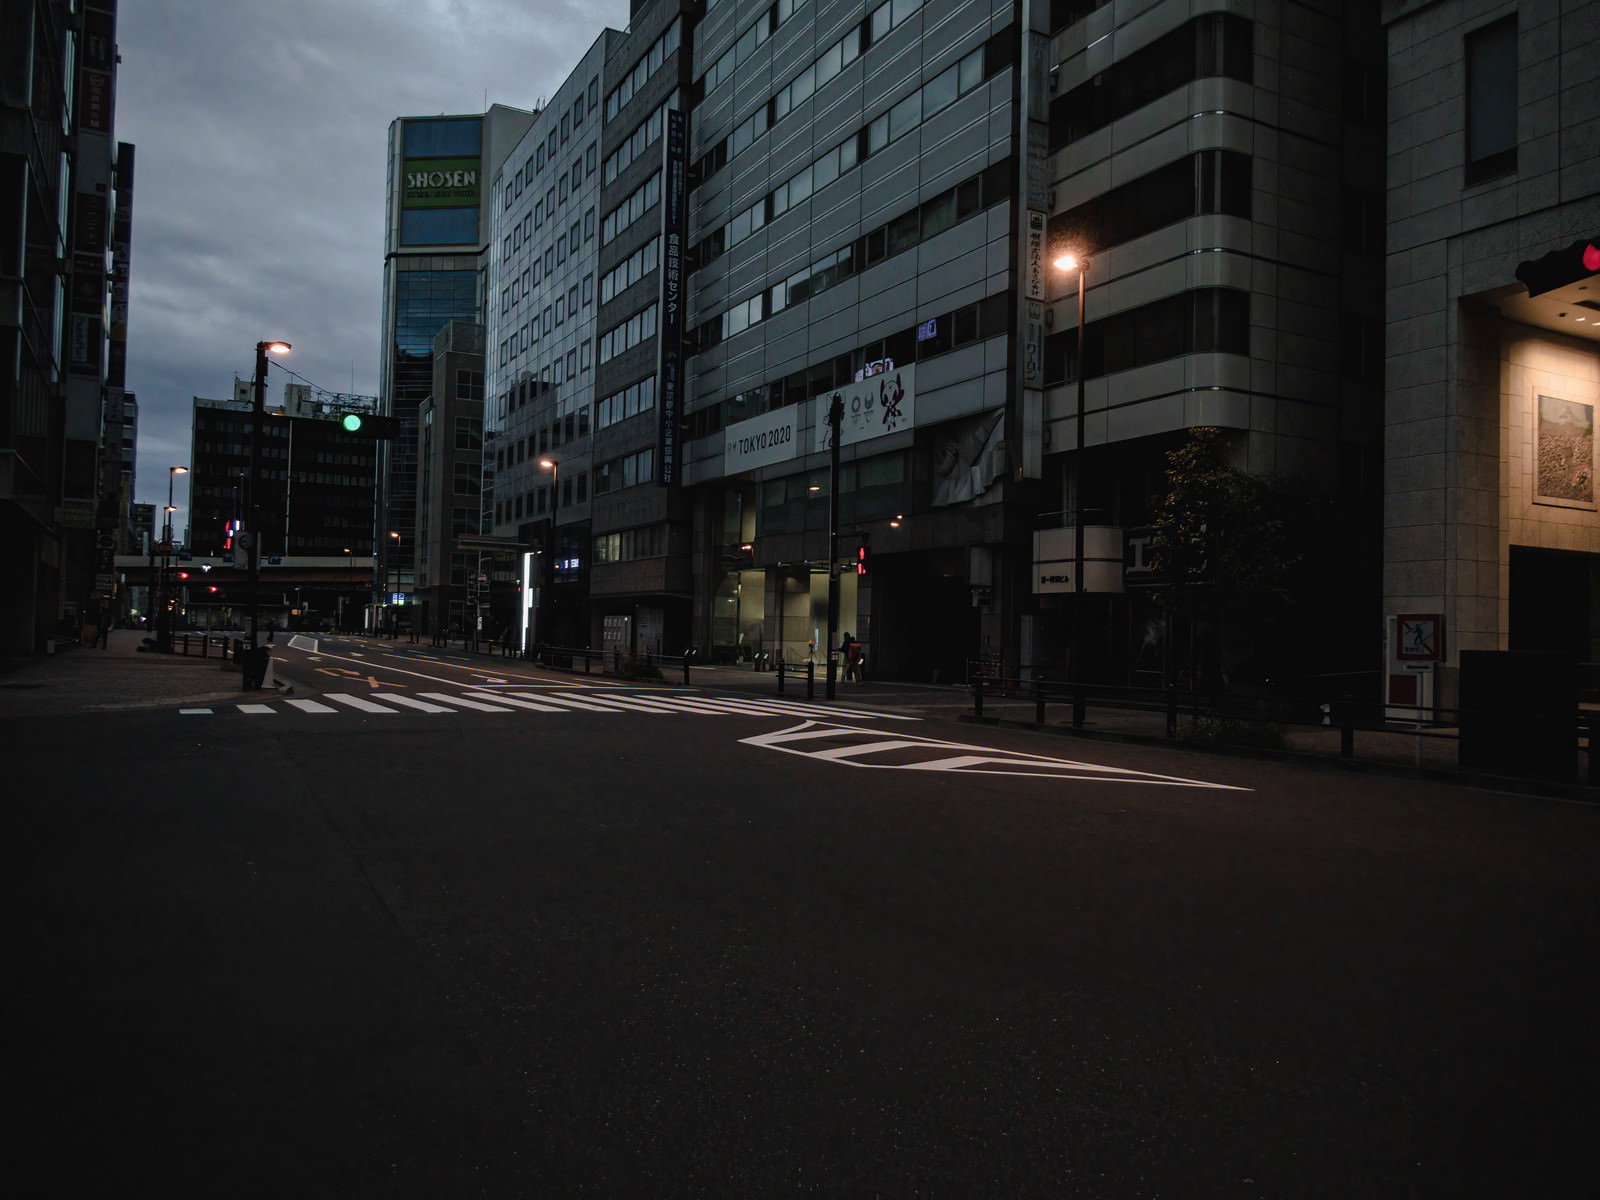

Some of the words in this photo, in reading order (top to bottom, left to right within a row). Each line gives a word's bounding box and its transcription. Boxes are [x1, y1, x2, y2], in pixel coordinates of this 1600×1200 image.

[407, 169, 476, 188] SHOSEN
[738, 432, 767, 455] TOKYO
[768, 425, 791, 447] 2020
